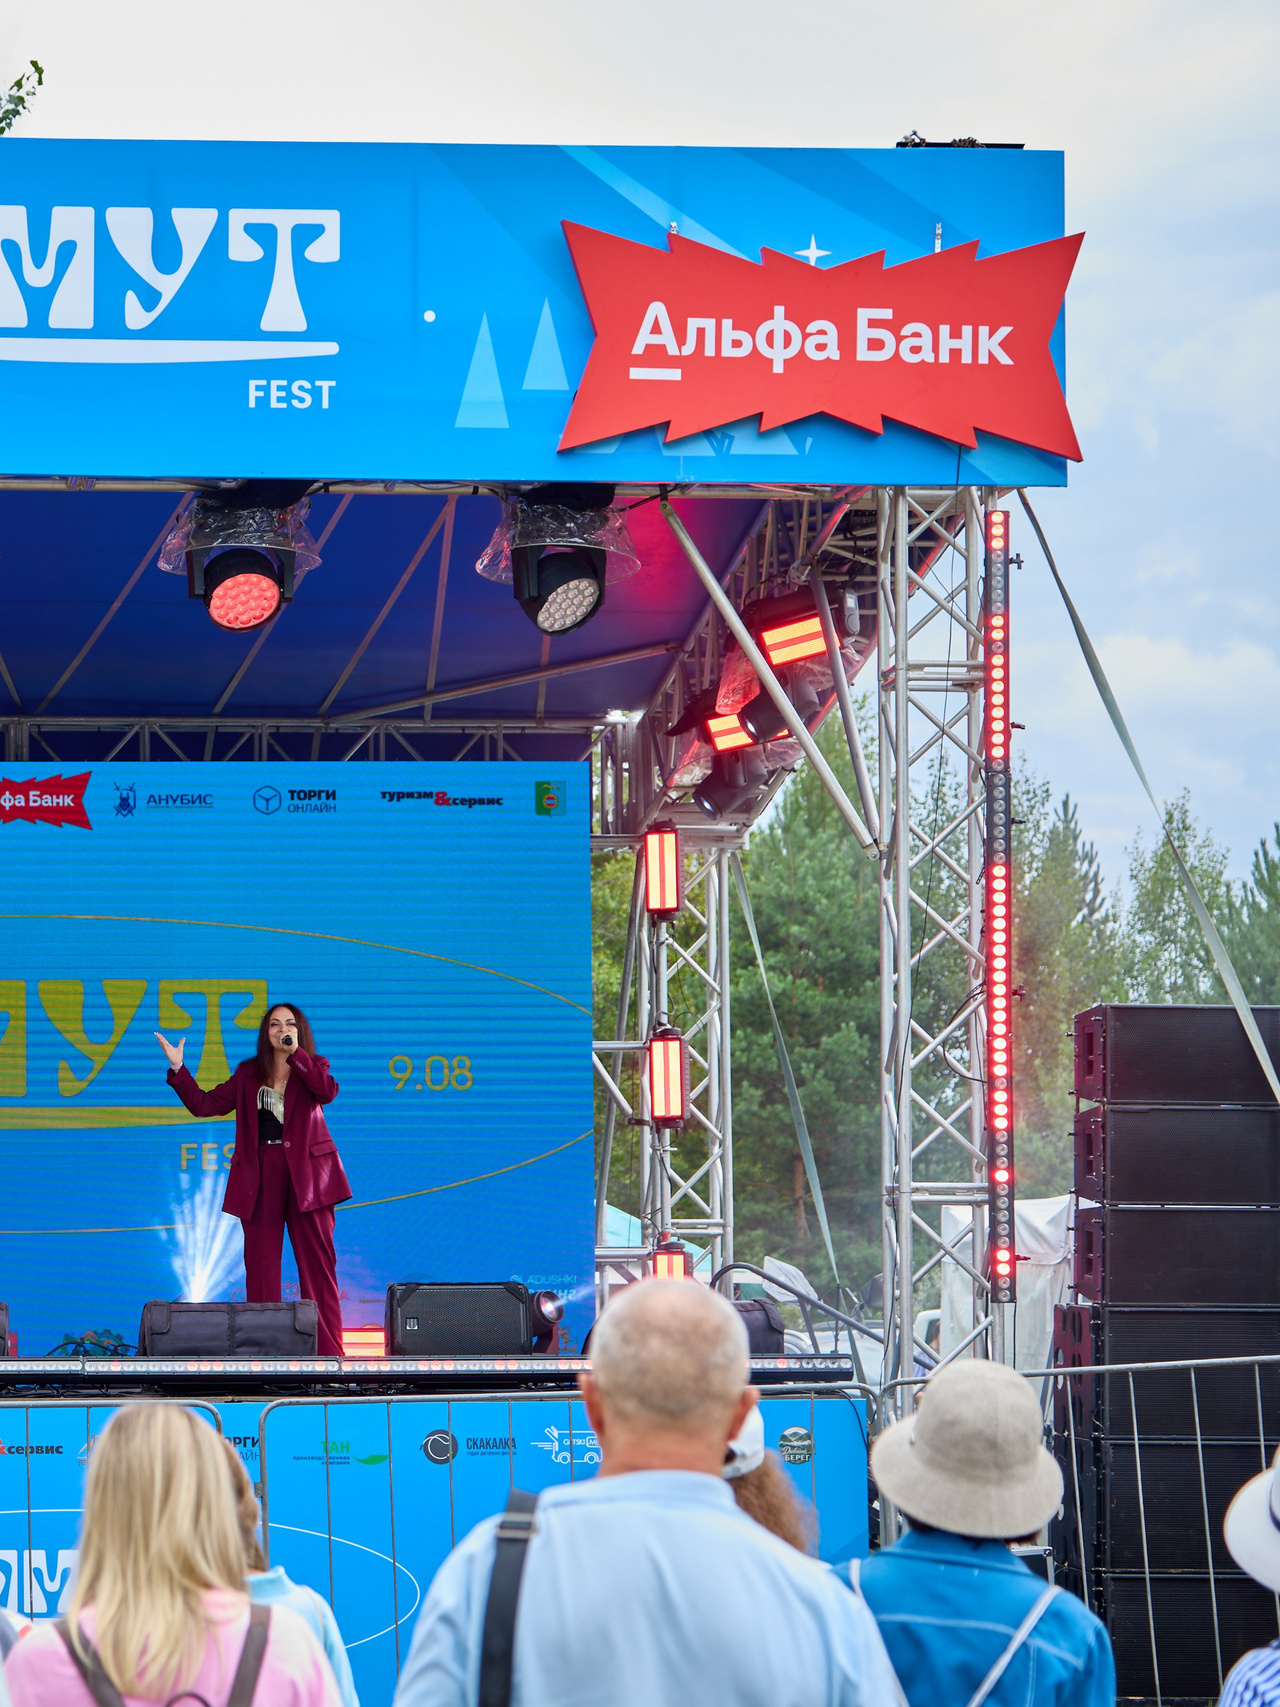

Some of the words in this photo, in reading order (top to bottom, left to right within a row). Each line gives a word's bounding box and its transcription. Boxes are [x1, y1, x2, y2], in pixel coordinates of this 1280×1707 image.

[629, 301, 840, 381] Альфа
[856, 307, 1015, 366] Банк
[248, 379, 336, 409] FEST
[28, 791, 75, 807] Банк
[146, 793, 214, 805] АНУБИС
[288, 789, 336, 801] ТОРГИ
[287, 800, 337, 813] ОНЛАЙН
[388, 1055, 474, 1091] 9.08
[180, 1143, 234, 1170] FES
[320, 1440, 350, 1454] ТАН
[466, 1437, 517, 1450] СКАКАЛКА
[562, 1438, 586, 1446] GTSKI
